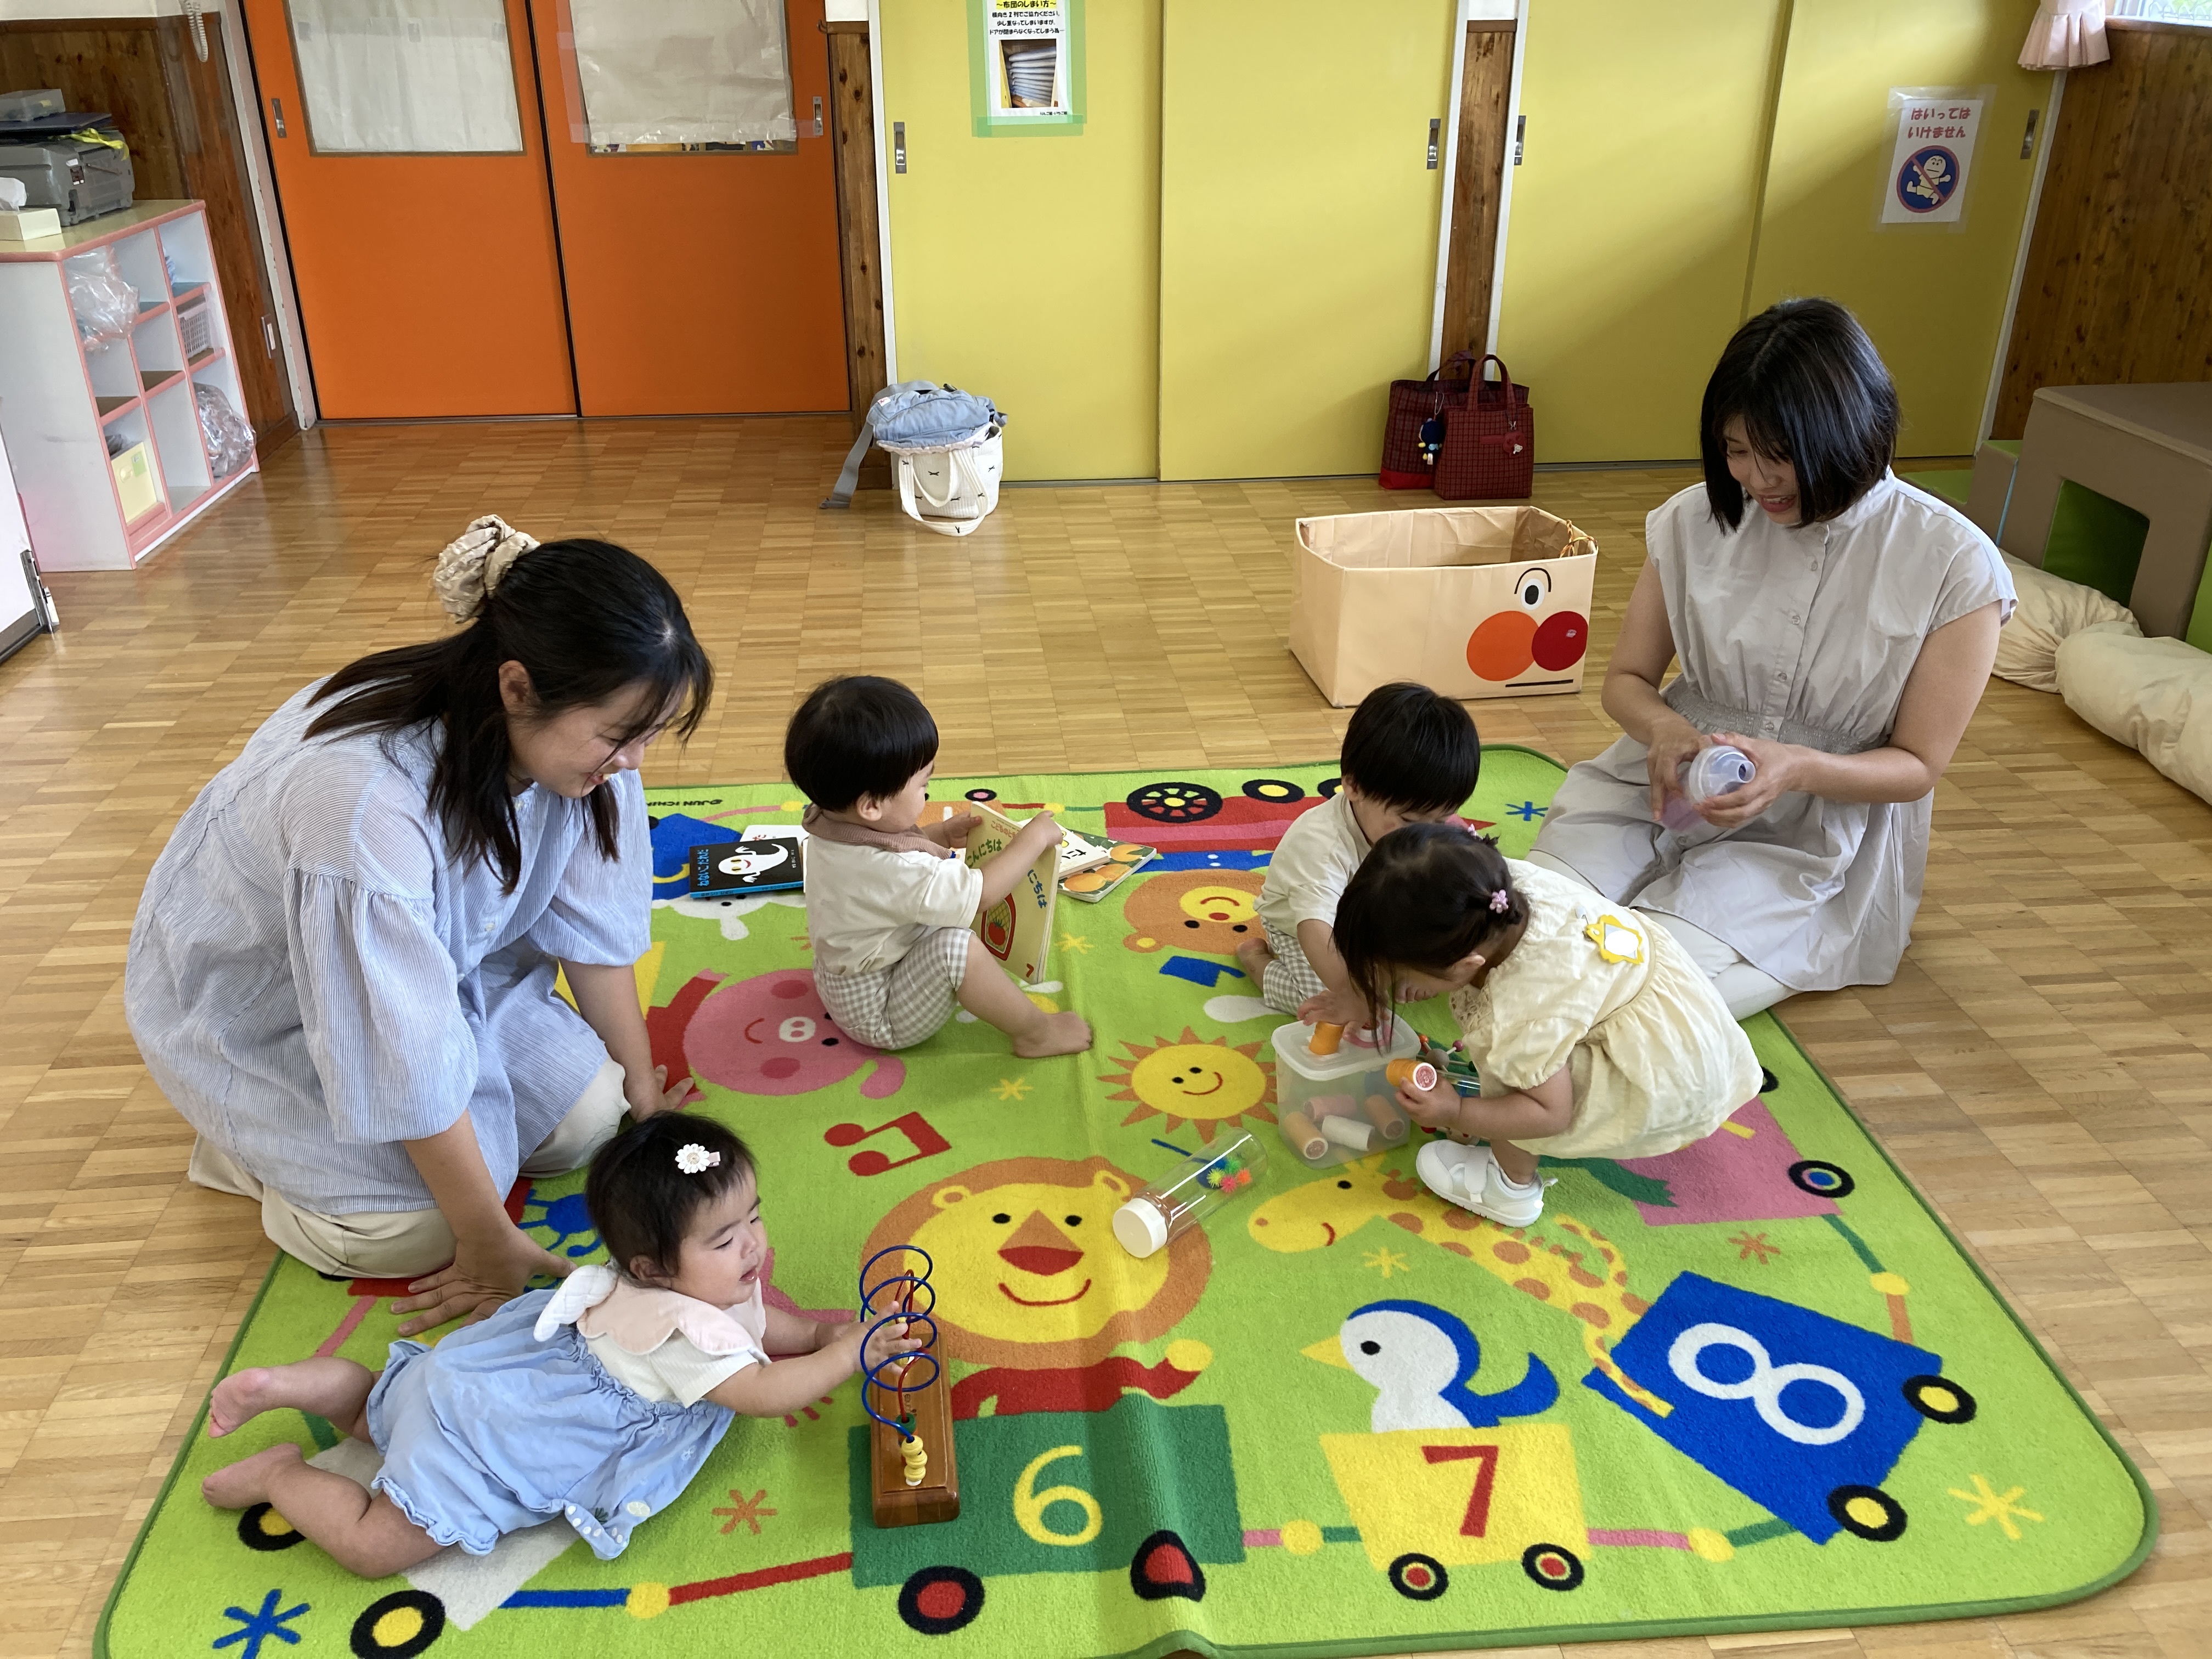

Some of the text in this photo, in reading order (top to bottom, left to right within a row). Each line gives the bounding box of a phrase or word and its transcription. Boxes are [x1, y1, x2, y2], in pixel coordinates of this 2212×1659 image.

[1908, 126, 1966, 139] いけません
[1911, 108, 1971, 120] はいっては
[967, 838, 1002, 868] こんにちは
[1668, 1322, 1865, 1446] 8
[1013, 1445, 1103, 1547] 6
[1420, 1444, 1499, 1538] 7
